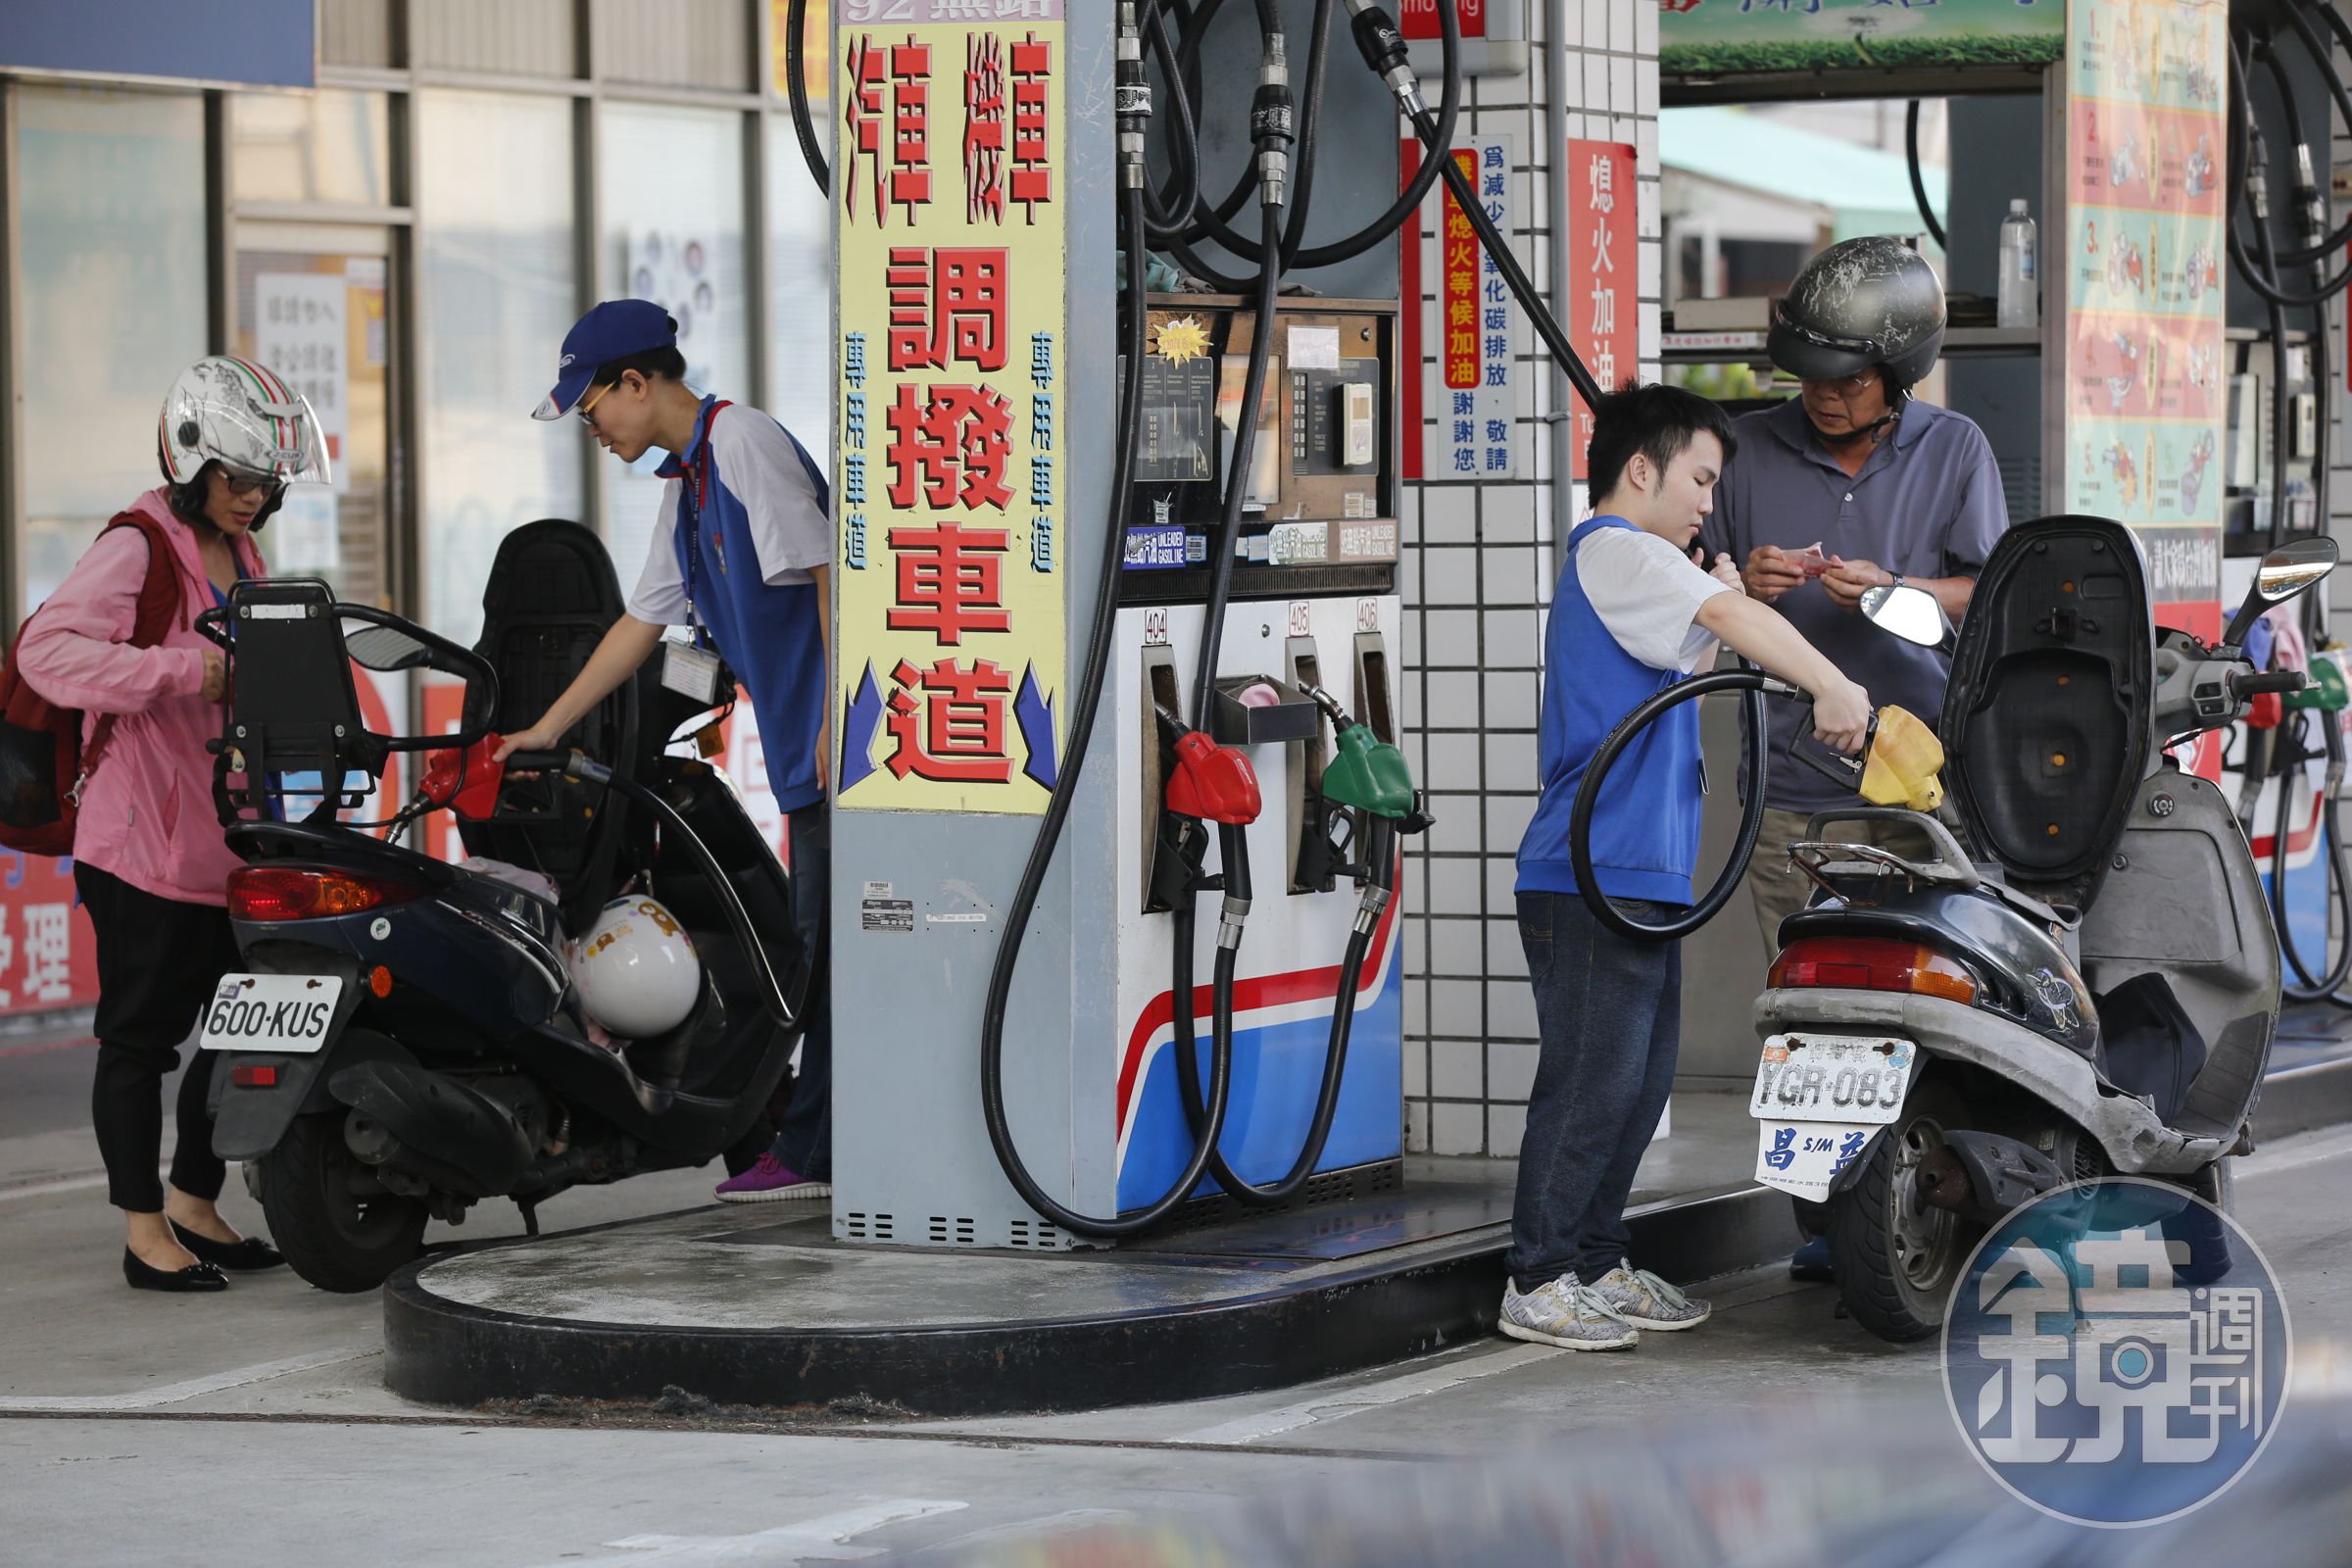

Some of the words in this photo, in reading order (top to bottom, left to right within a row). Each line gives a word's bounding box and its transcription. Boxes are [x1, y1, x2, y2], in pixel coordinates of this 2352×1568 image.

[846, 31, 933, 229] 汽車
[1590, 154, 1615, 393] 熄火加油
[845, 330, 867, 572] 專用車道
[1030, 330, 1054, 574] 專用車道
[1453, 392, 1475, 471] 謝謝您
[883, 246, 1017, 784] 調撥車道
[1157, 530, 1184, 548] UNLEADED
[1157, 548, 1184, 564] GASOLINE
[1147, 612, 1165, 639] 404
[1291, 606, 1308, 632] 405
[1358, 603, 1376, 629] 406
[208, 1000, 329, 1039] 600-KUS
[1765, 1127, 1797, 1172] 昌
